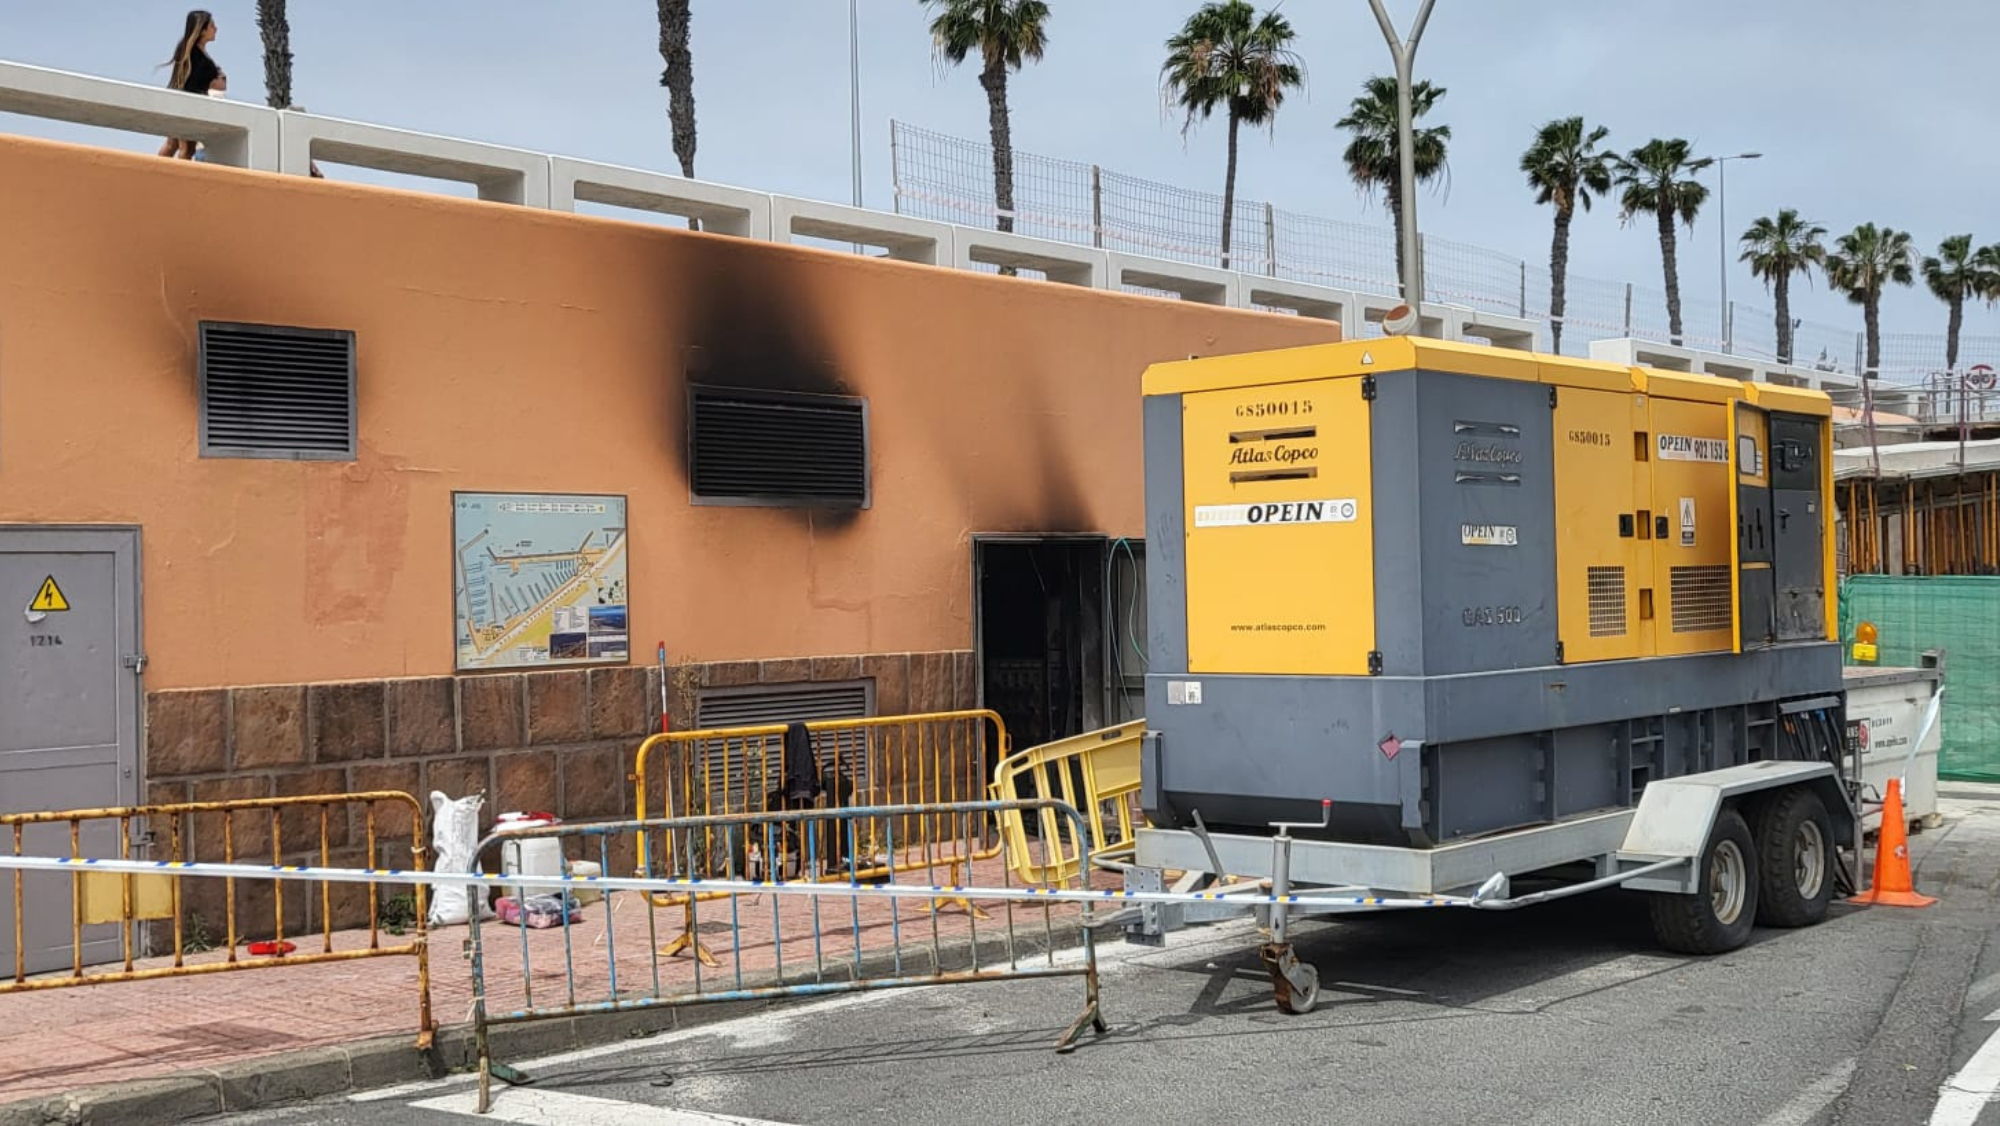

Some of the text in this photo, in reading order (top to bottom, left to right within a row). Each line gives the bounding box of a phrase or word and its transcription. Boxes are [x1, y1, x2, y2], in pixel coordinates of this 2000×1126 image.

[1236, 400, 1313, 417] GS50015
[1569, 430, 1611, 447] GS50015
[1660, 435, 1692, 452] OPEIN
[1228, 445, 1319, 466] Atlas Copco
[1248, 501, 1325, 525] OPEIN
[1463, 523, 1496, 538] OPEIN
[1231, 622, 1326, 633] www.atlascopco.com
[30, 635, 63, 647] 1214
